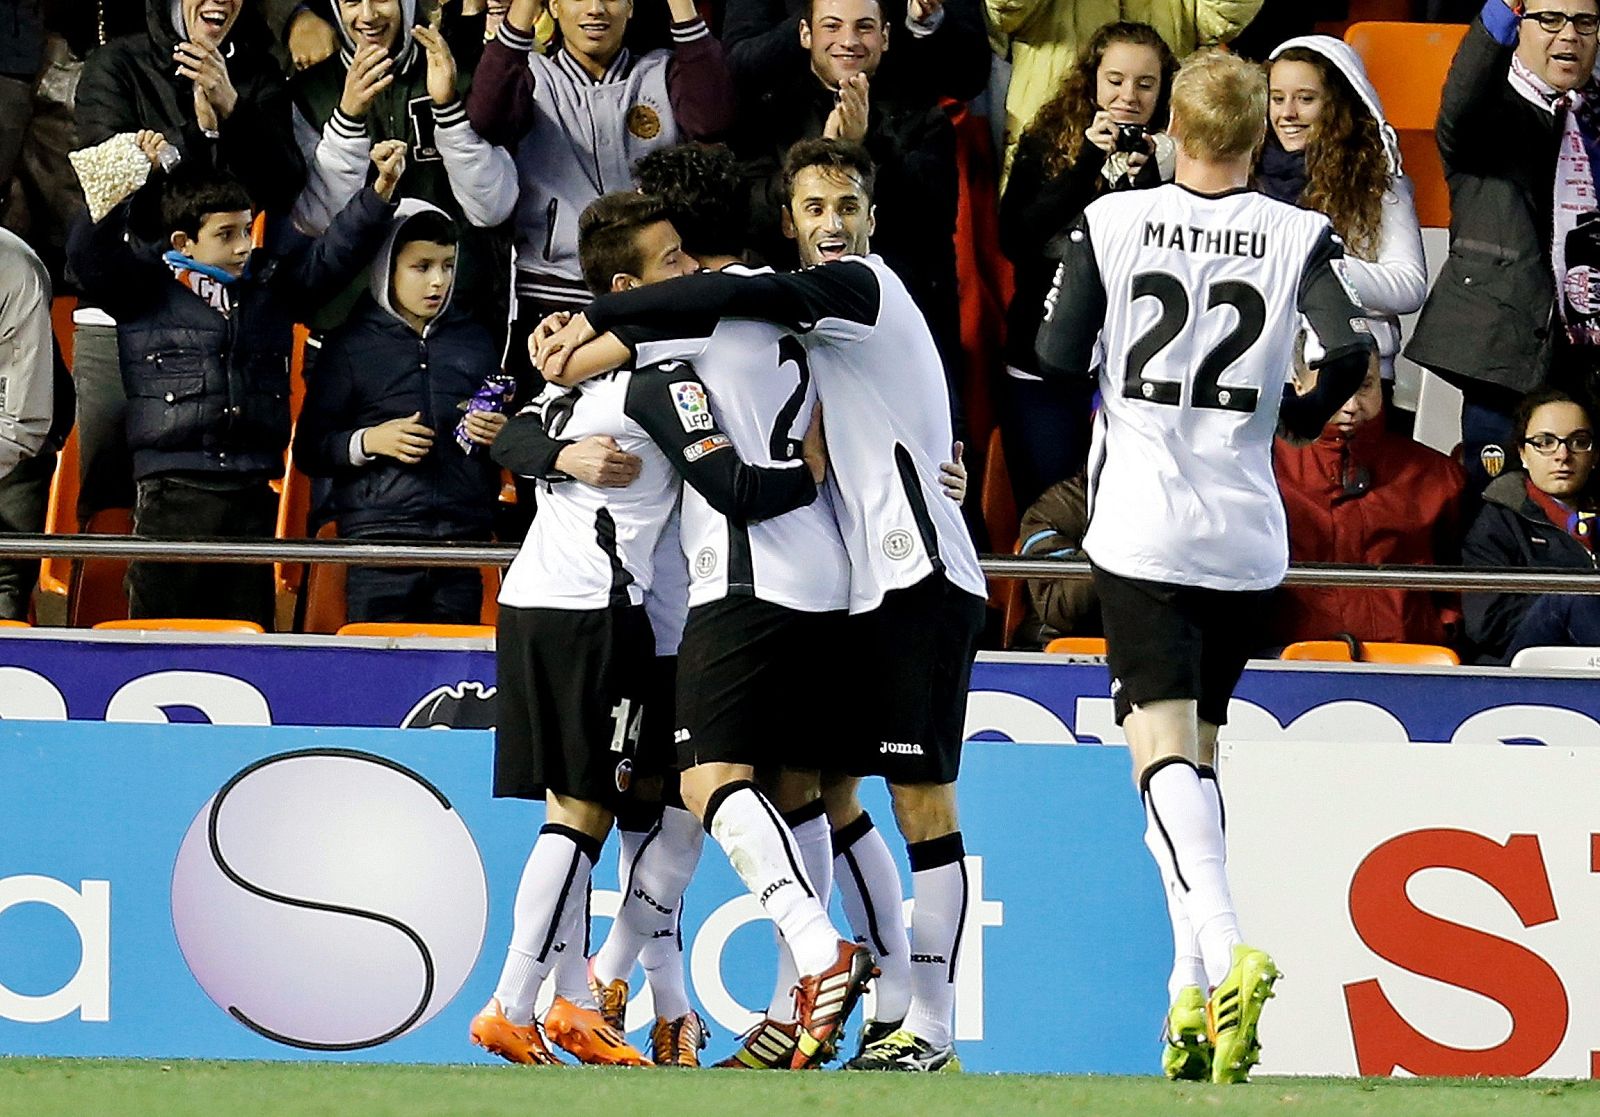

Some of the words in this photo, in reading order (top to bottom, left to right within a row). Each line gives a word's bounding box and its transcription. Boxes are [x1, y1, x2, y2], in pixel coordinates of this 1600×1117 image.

[1143, 220, 1267, 260] MATHIEU
[1122, 271, 1267, 413] 22
[686, 413, 709, 428] LFP
[610, 698, 644, 755] 14
[879, 741, 924, 755] Joma
